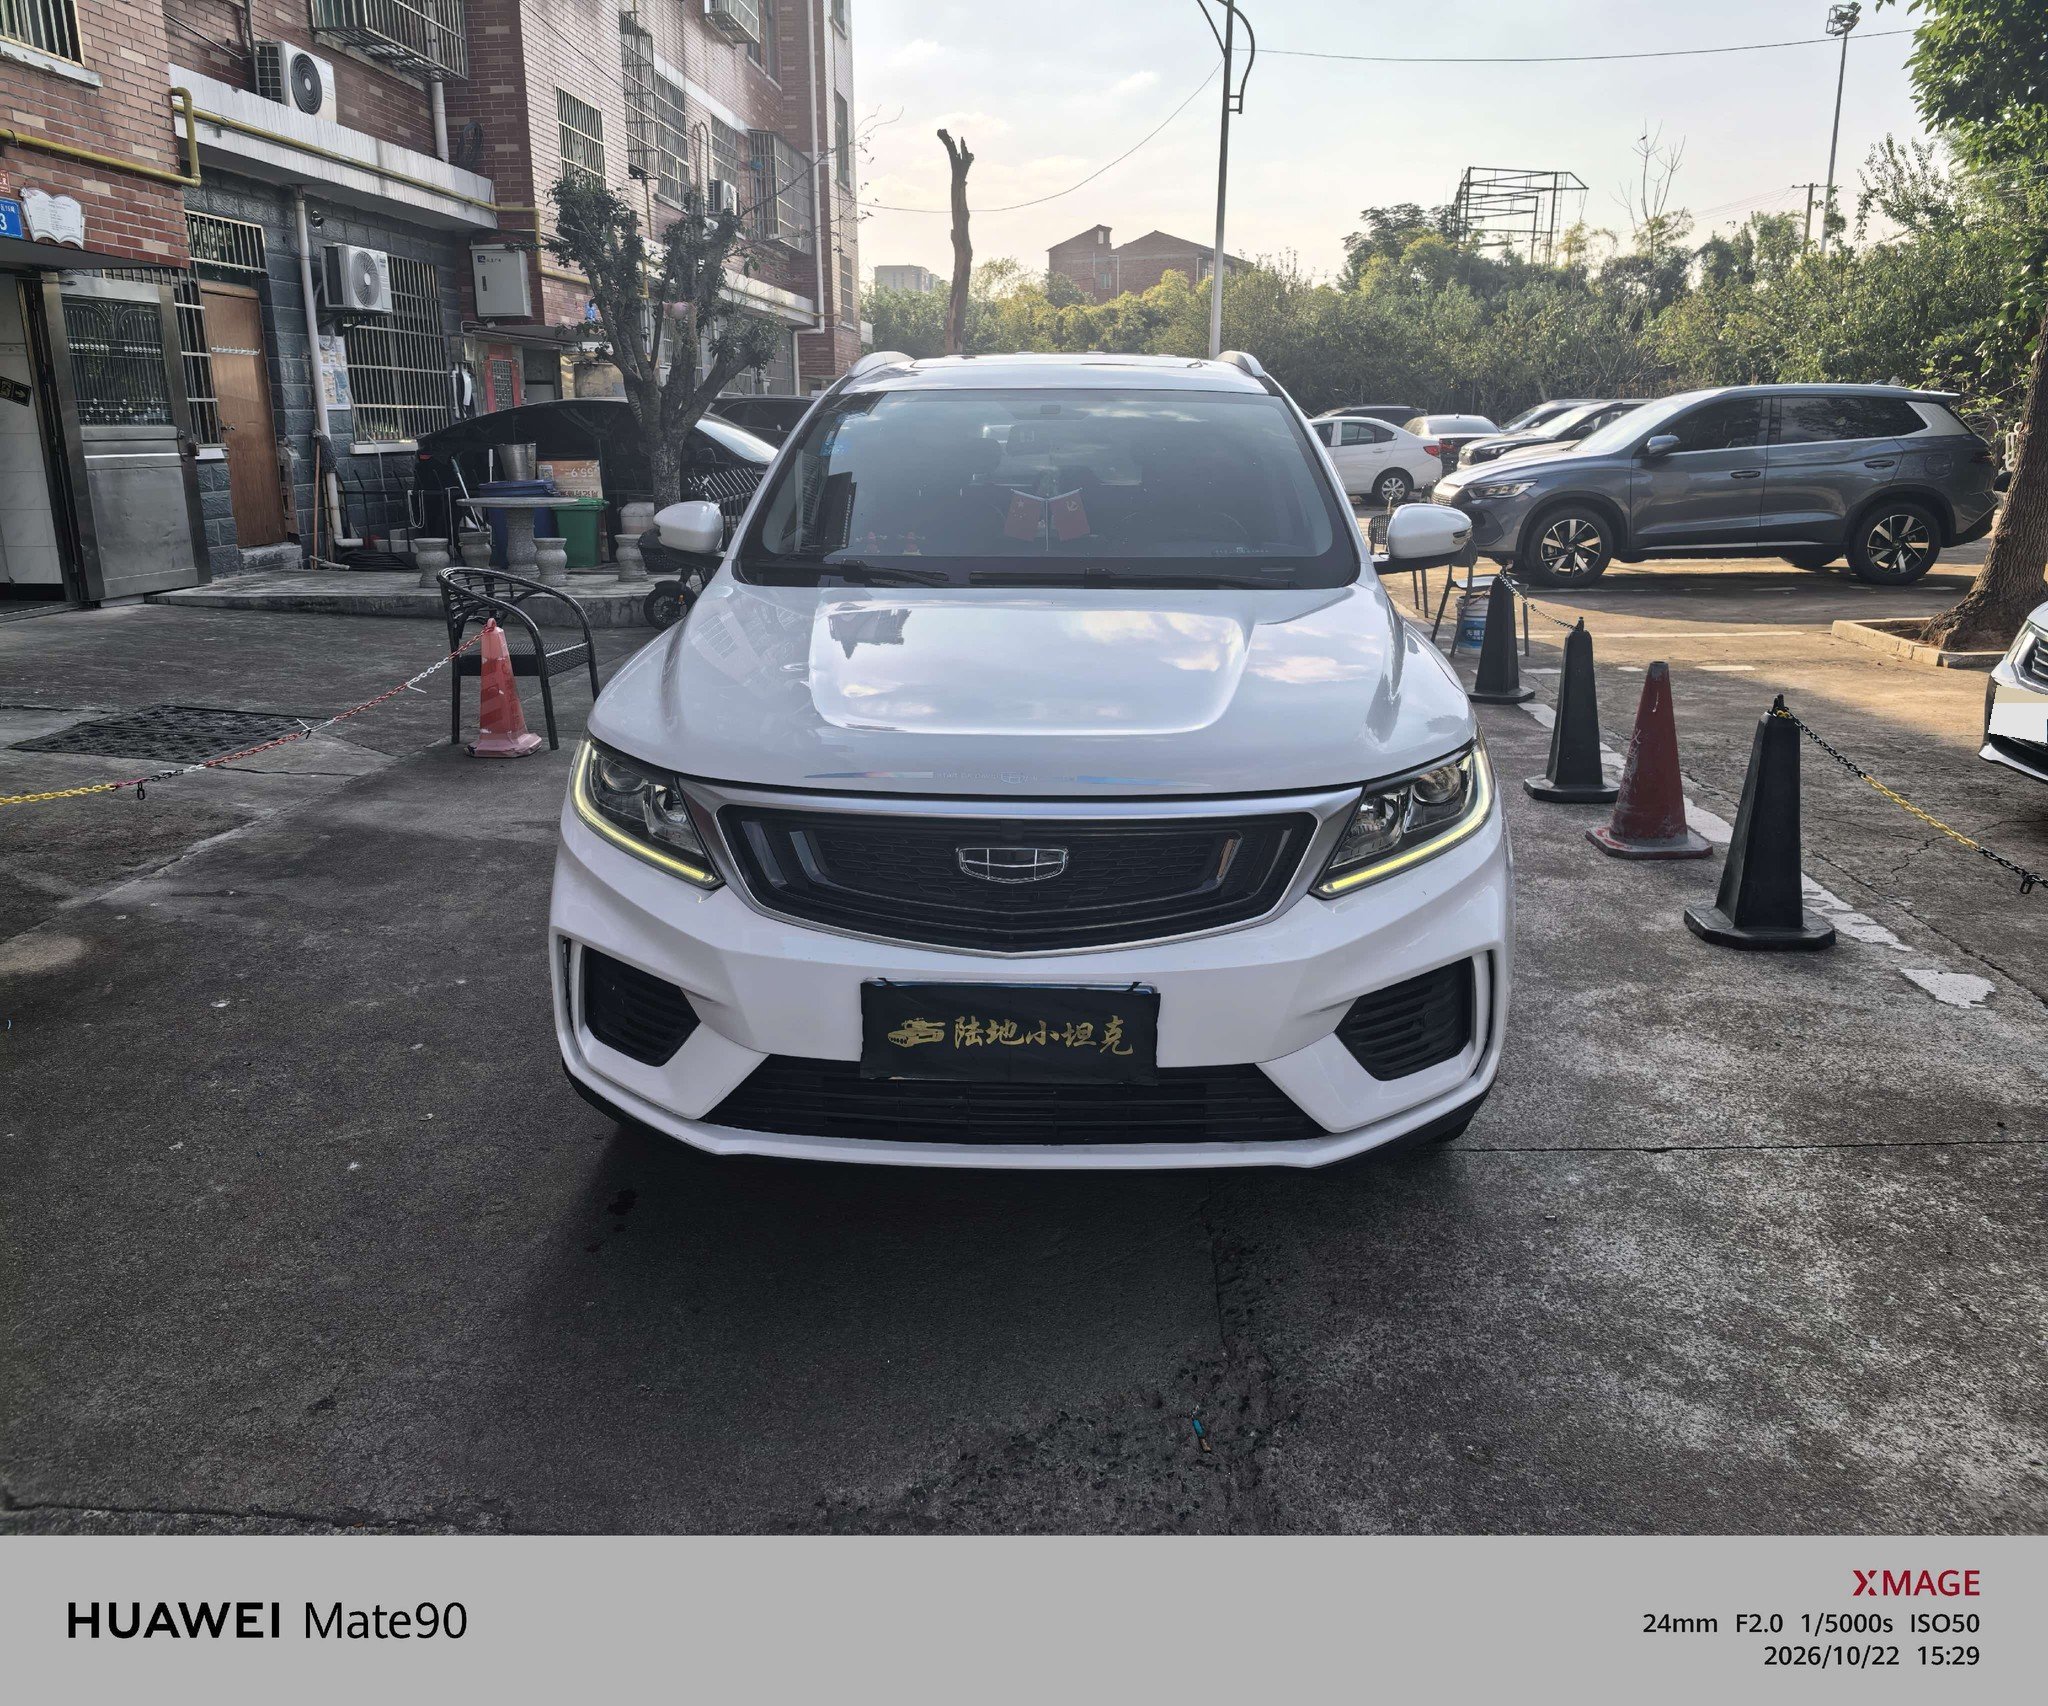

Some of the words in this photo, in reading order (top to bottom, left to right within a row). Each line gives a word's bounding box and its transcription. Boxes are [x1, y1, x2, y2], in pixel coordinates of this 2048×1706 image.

[572, 468, 594, 478] 55.9
[954, 1015, 1134, 1056] 陆地小坦克
